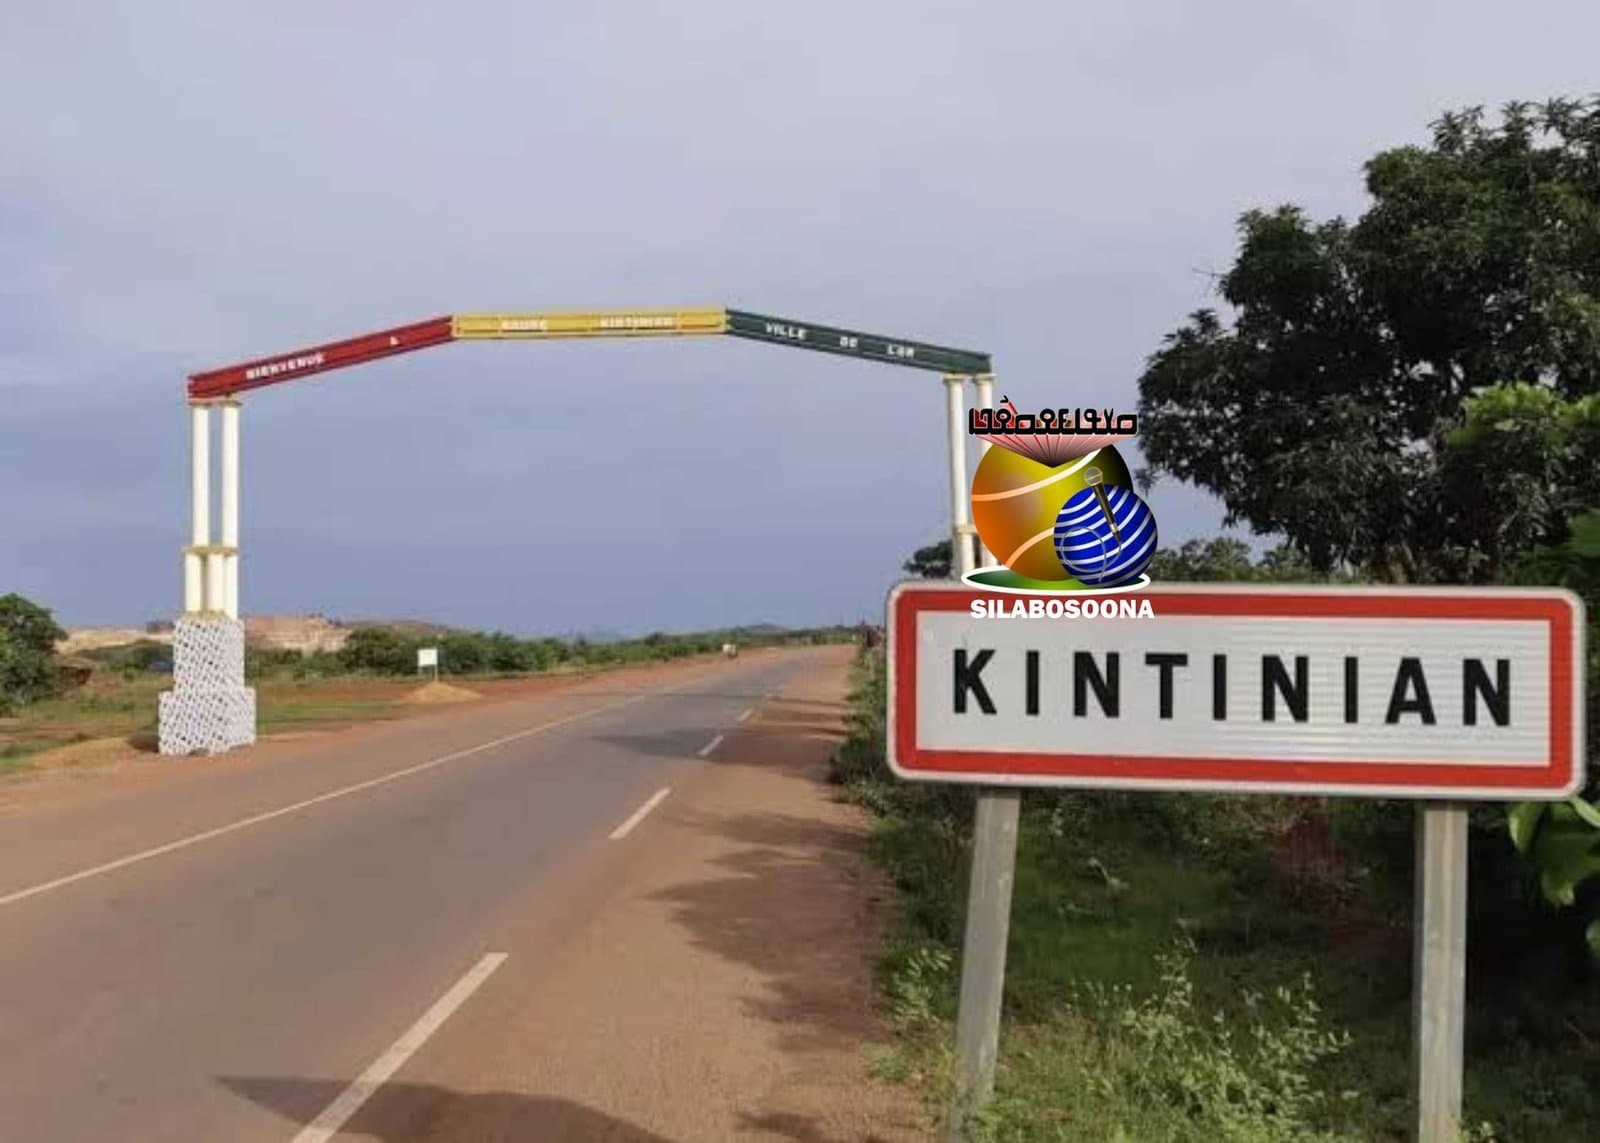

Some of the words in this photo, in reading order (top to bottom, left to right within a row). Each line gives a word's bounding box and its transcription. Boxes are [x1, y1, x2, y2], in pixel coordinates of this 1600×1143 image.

[765, 322, 808, 341] VILLE
[839, 335, 858, 348] DE
[952, 648, 1512, 727] KINTINIAN
